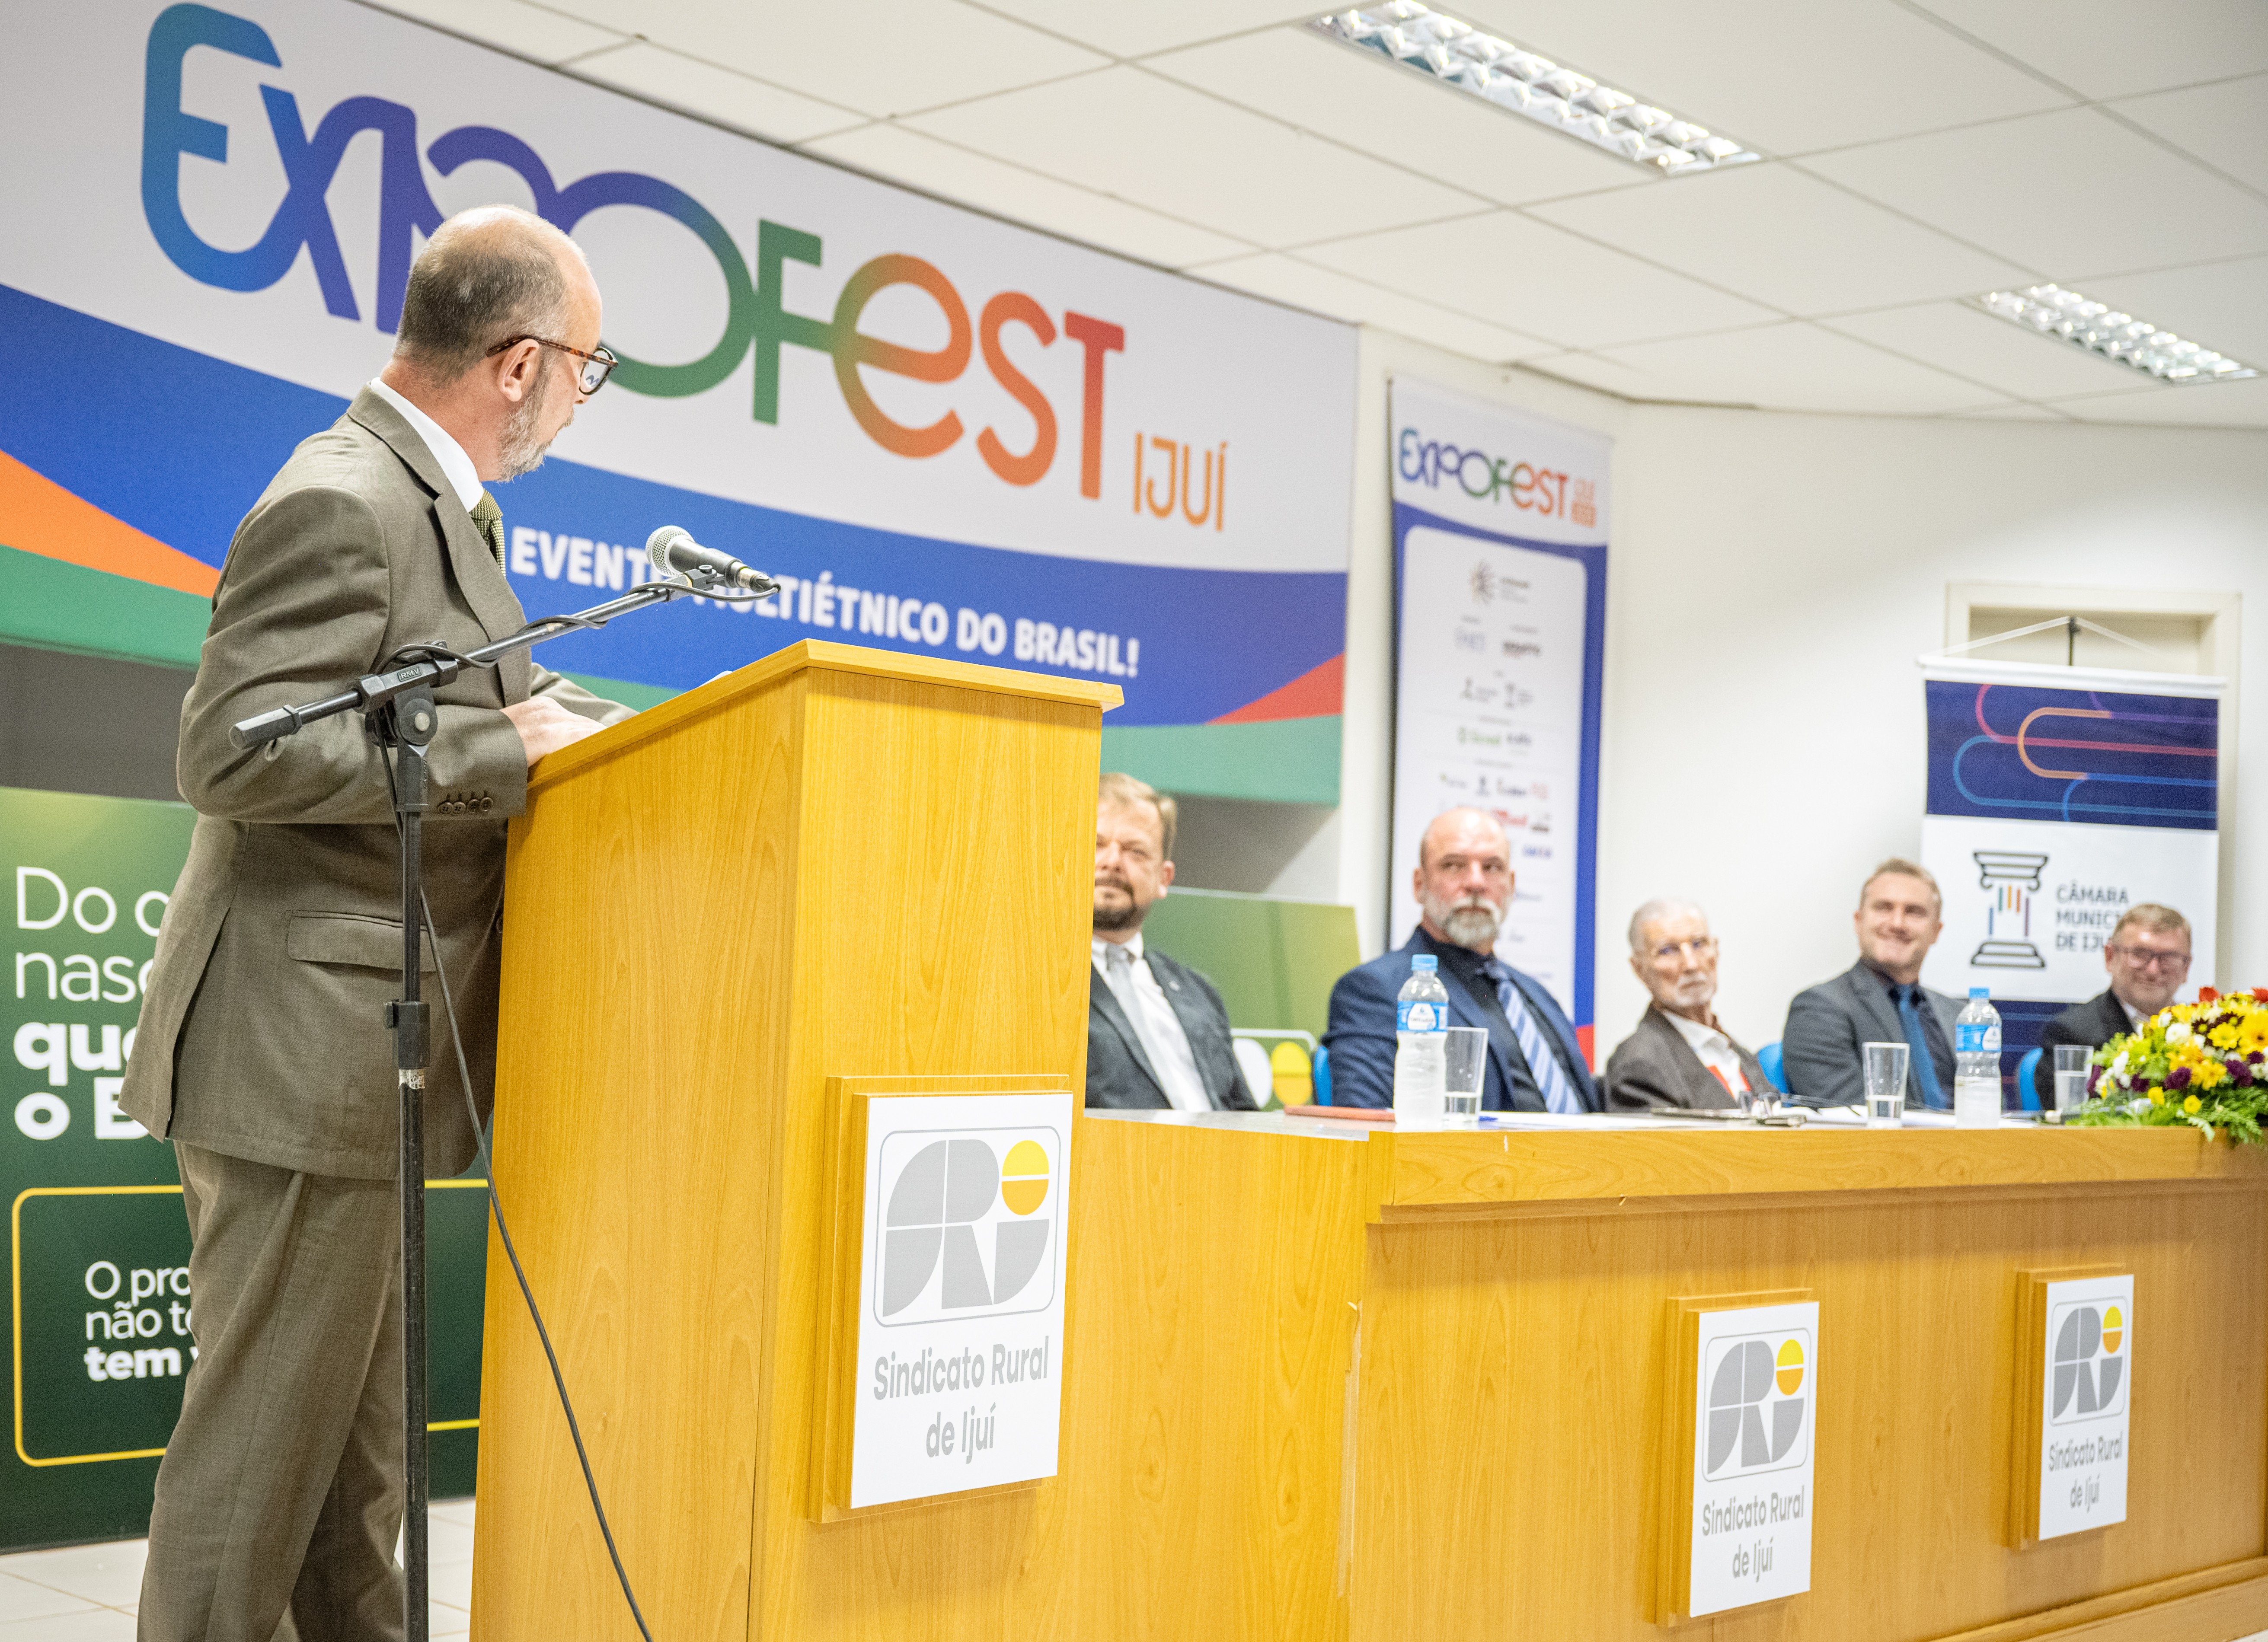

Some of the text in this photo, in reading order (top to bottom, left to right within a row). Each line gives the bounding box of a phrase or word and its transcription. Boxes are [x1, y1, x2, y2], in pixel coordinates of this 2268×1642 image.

[1132, 431, 1229, 532] IJUÍ
[510, 525, 1140, 679] EVENT LTIÉTNICO DO BRASIL!
[400, 668, 418, 679] RMV
[16, 866, 118, 934] Do
[2056, 880, 2129, 905] CÂMARA
[2055, 931, 2077, 952] DE
[13, 1021, 137, 1086] qu
[14, 1091, 70, 1141] o
[84, 1260, 121, 1300] O
[86, 1300, 193, 1340] não t
[83, 1345, 182, 1382] tem
[873, 1335, 1050, 1401] Sindicato Rural
[926, 1402, 997, 1464] de Ijuí
[2048, 1430, 2123, 1472] Sindicato Rural
[1702, 1485, 1805, 1536] Sindicato Rural
[2070, 1473, 2100, 1513] de Ijuí
[1732, 1536, 1774, 1583] de Ijuí
